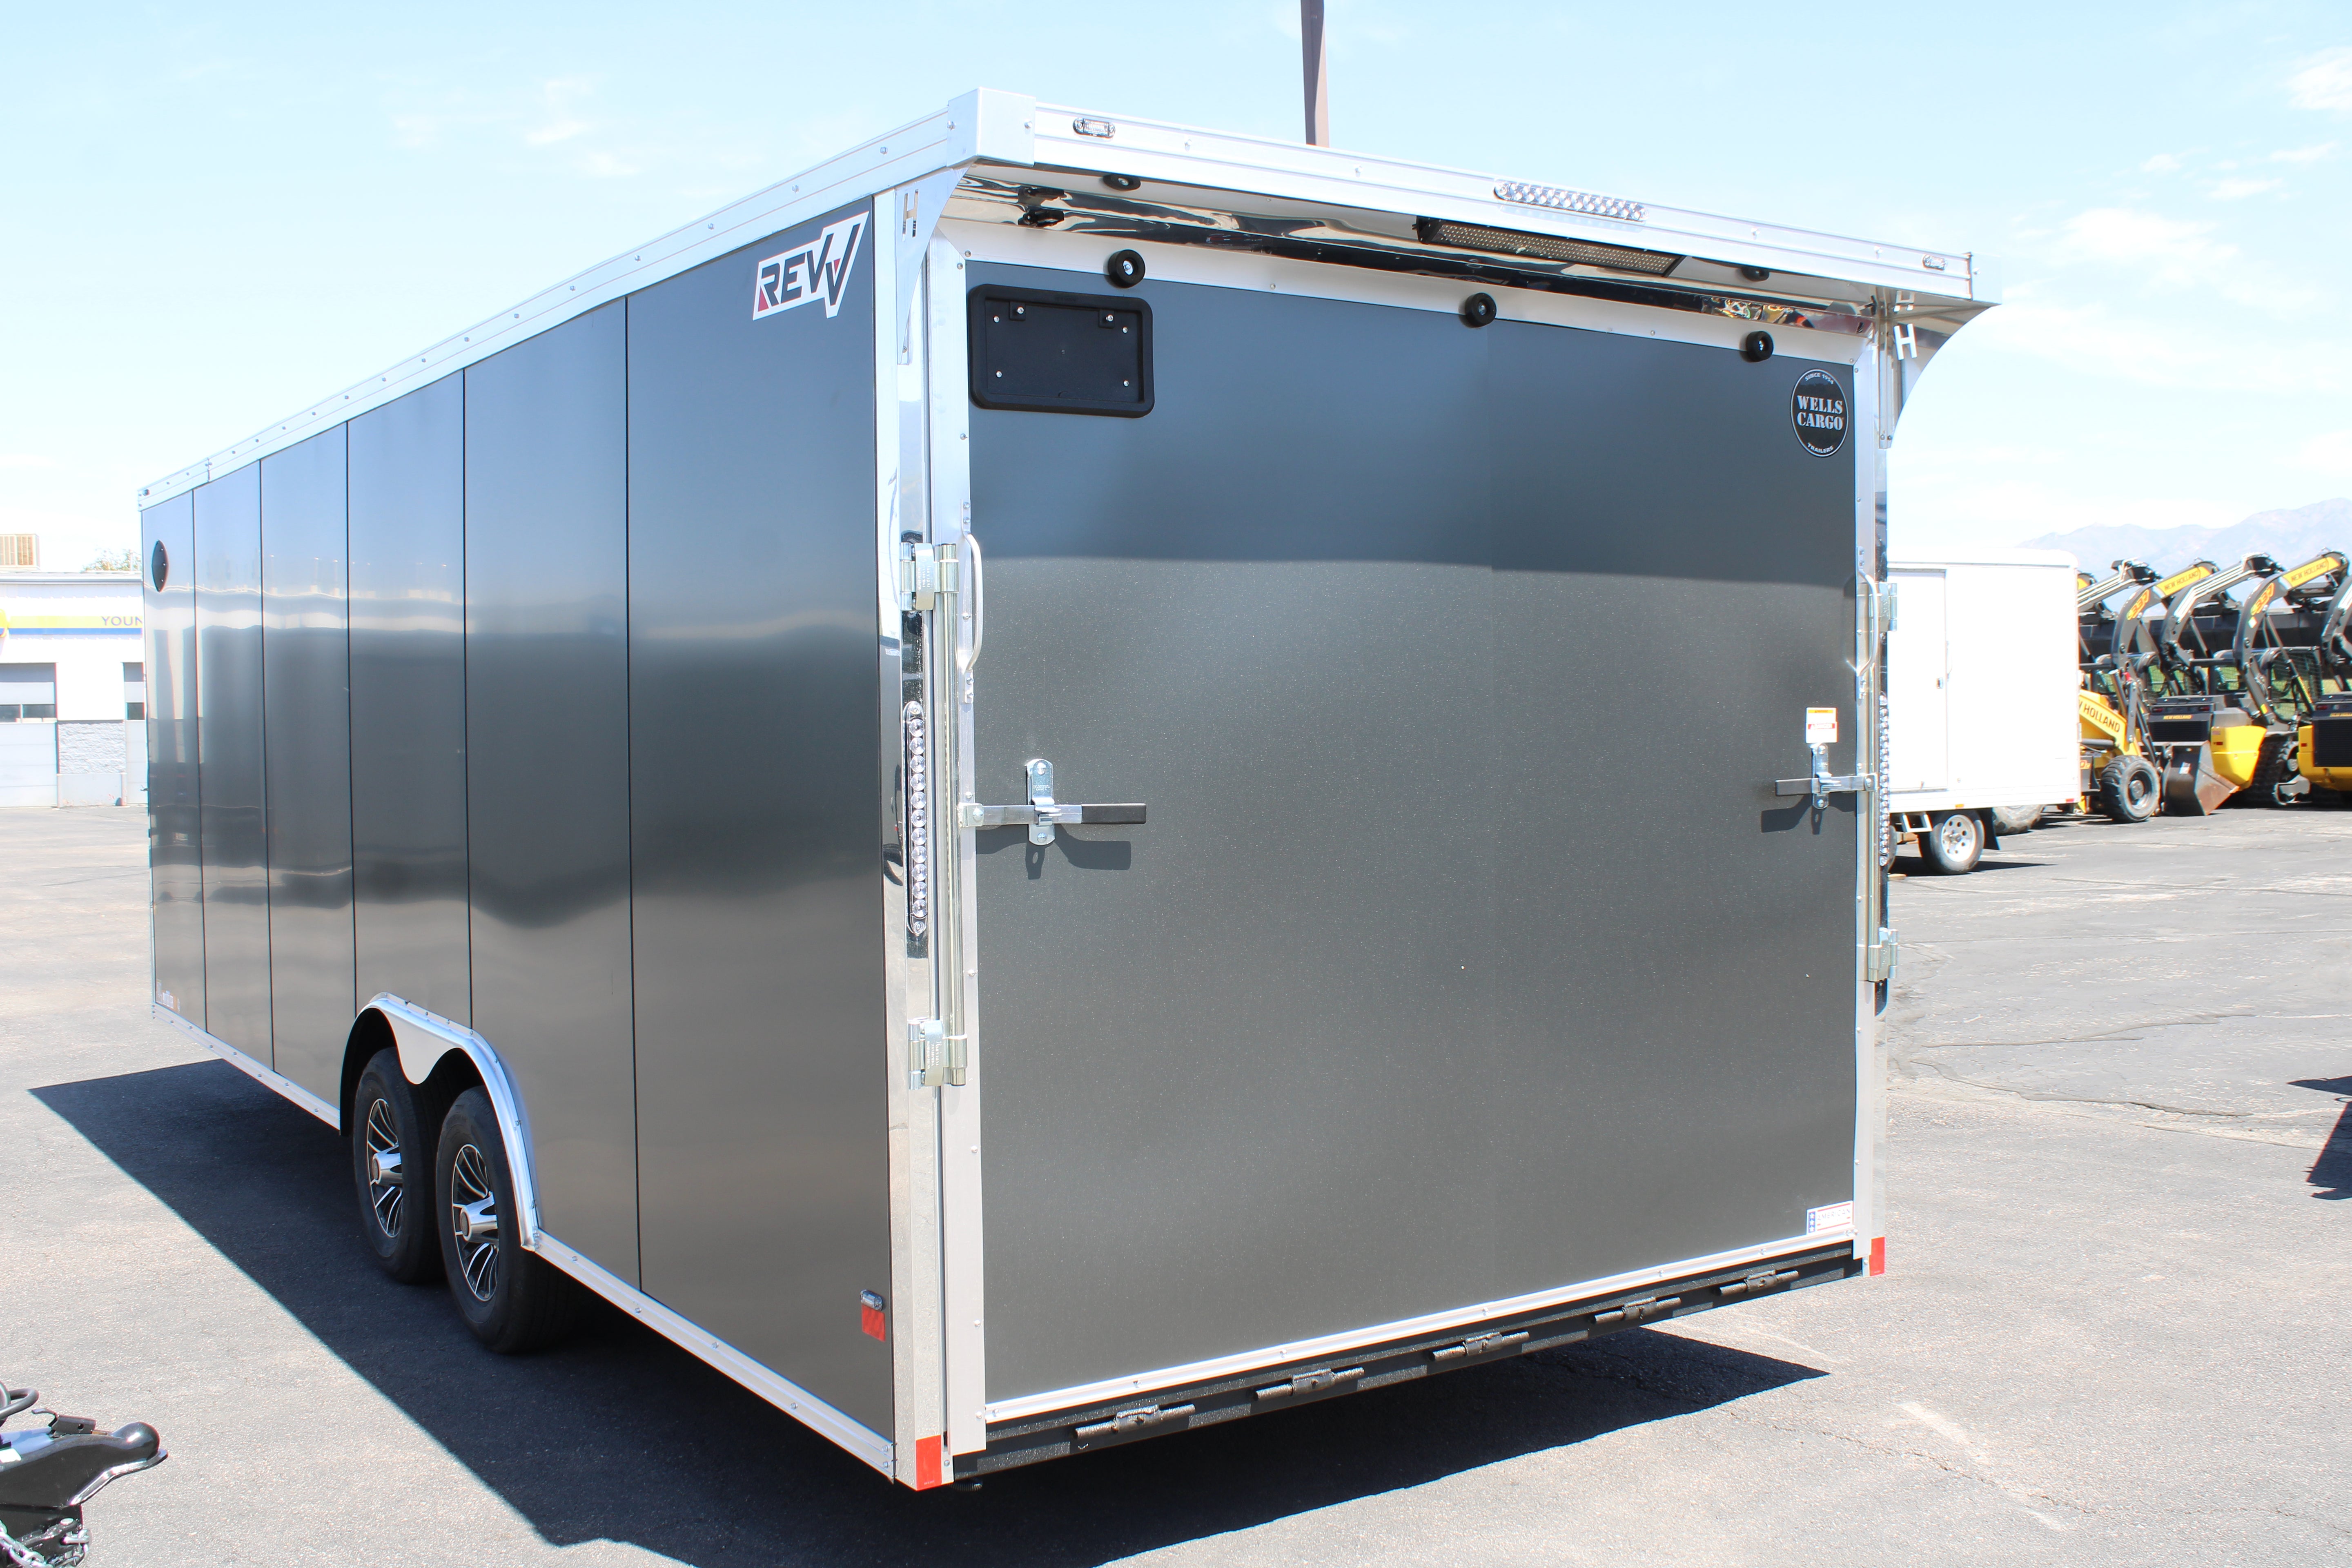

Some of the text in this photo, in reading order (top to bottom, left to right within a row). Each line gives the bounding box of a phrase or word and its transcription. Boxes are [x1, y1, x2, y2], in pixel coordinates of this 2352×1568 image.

[1805, 372, 1821, 381] SINCE
[1797, 395, 1842, 414] WELLS
[1797, 412, 1843, 430] CARGO
[1807, 442, 1833, 453] TRAILERS
[2165, 571, 2198, 590] NEW HOLLAND
[2291, 562, 2326, 581] NEW HOLLAND
[2084, 704, 2120, 733] HOLLAND
